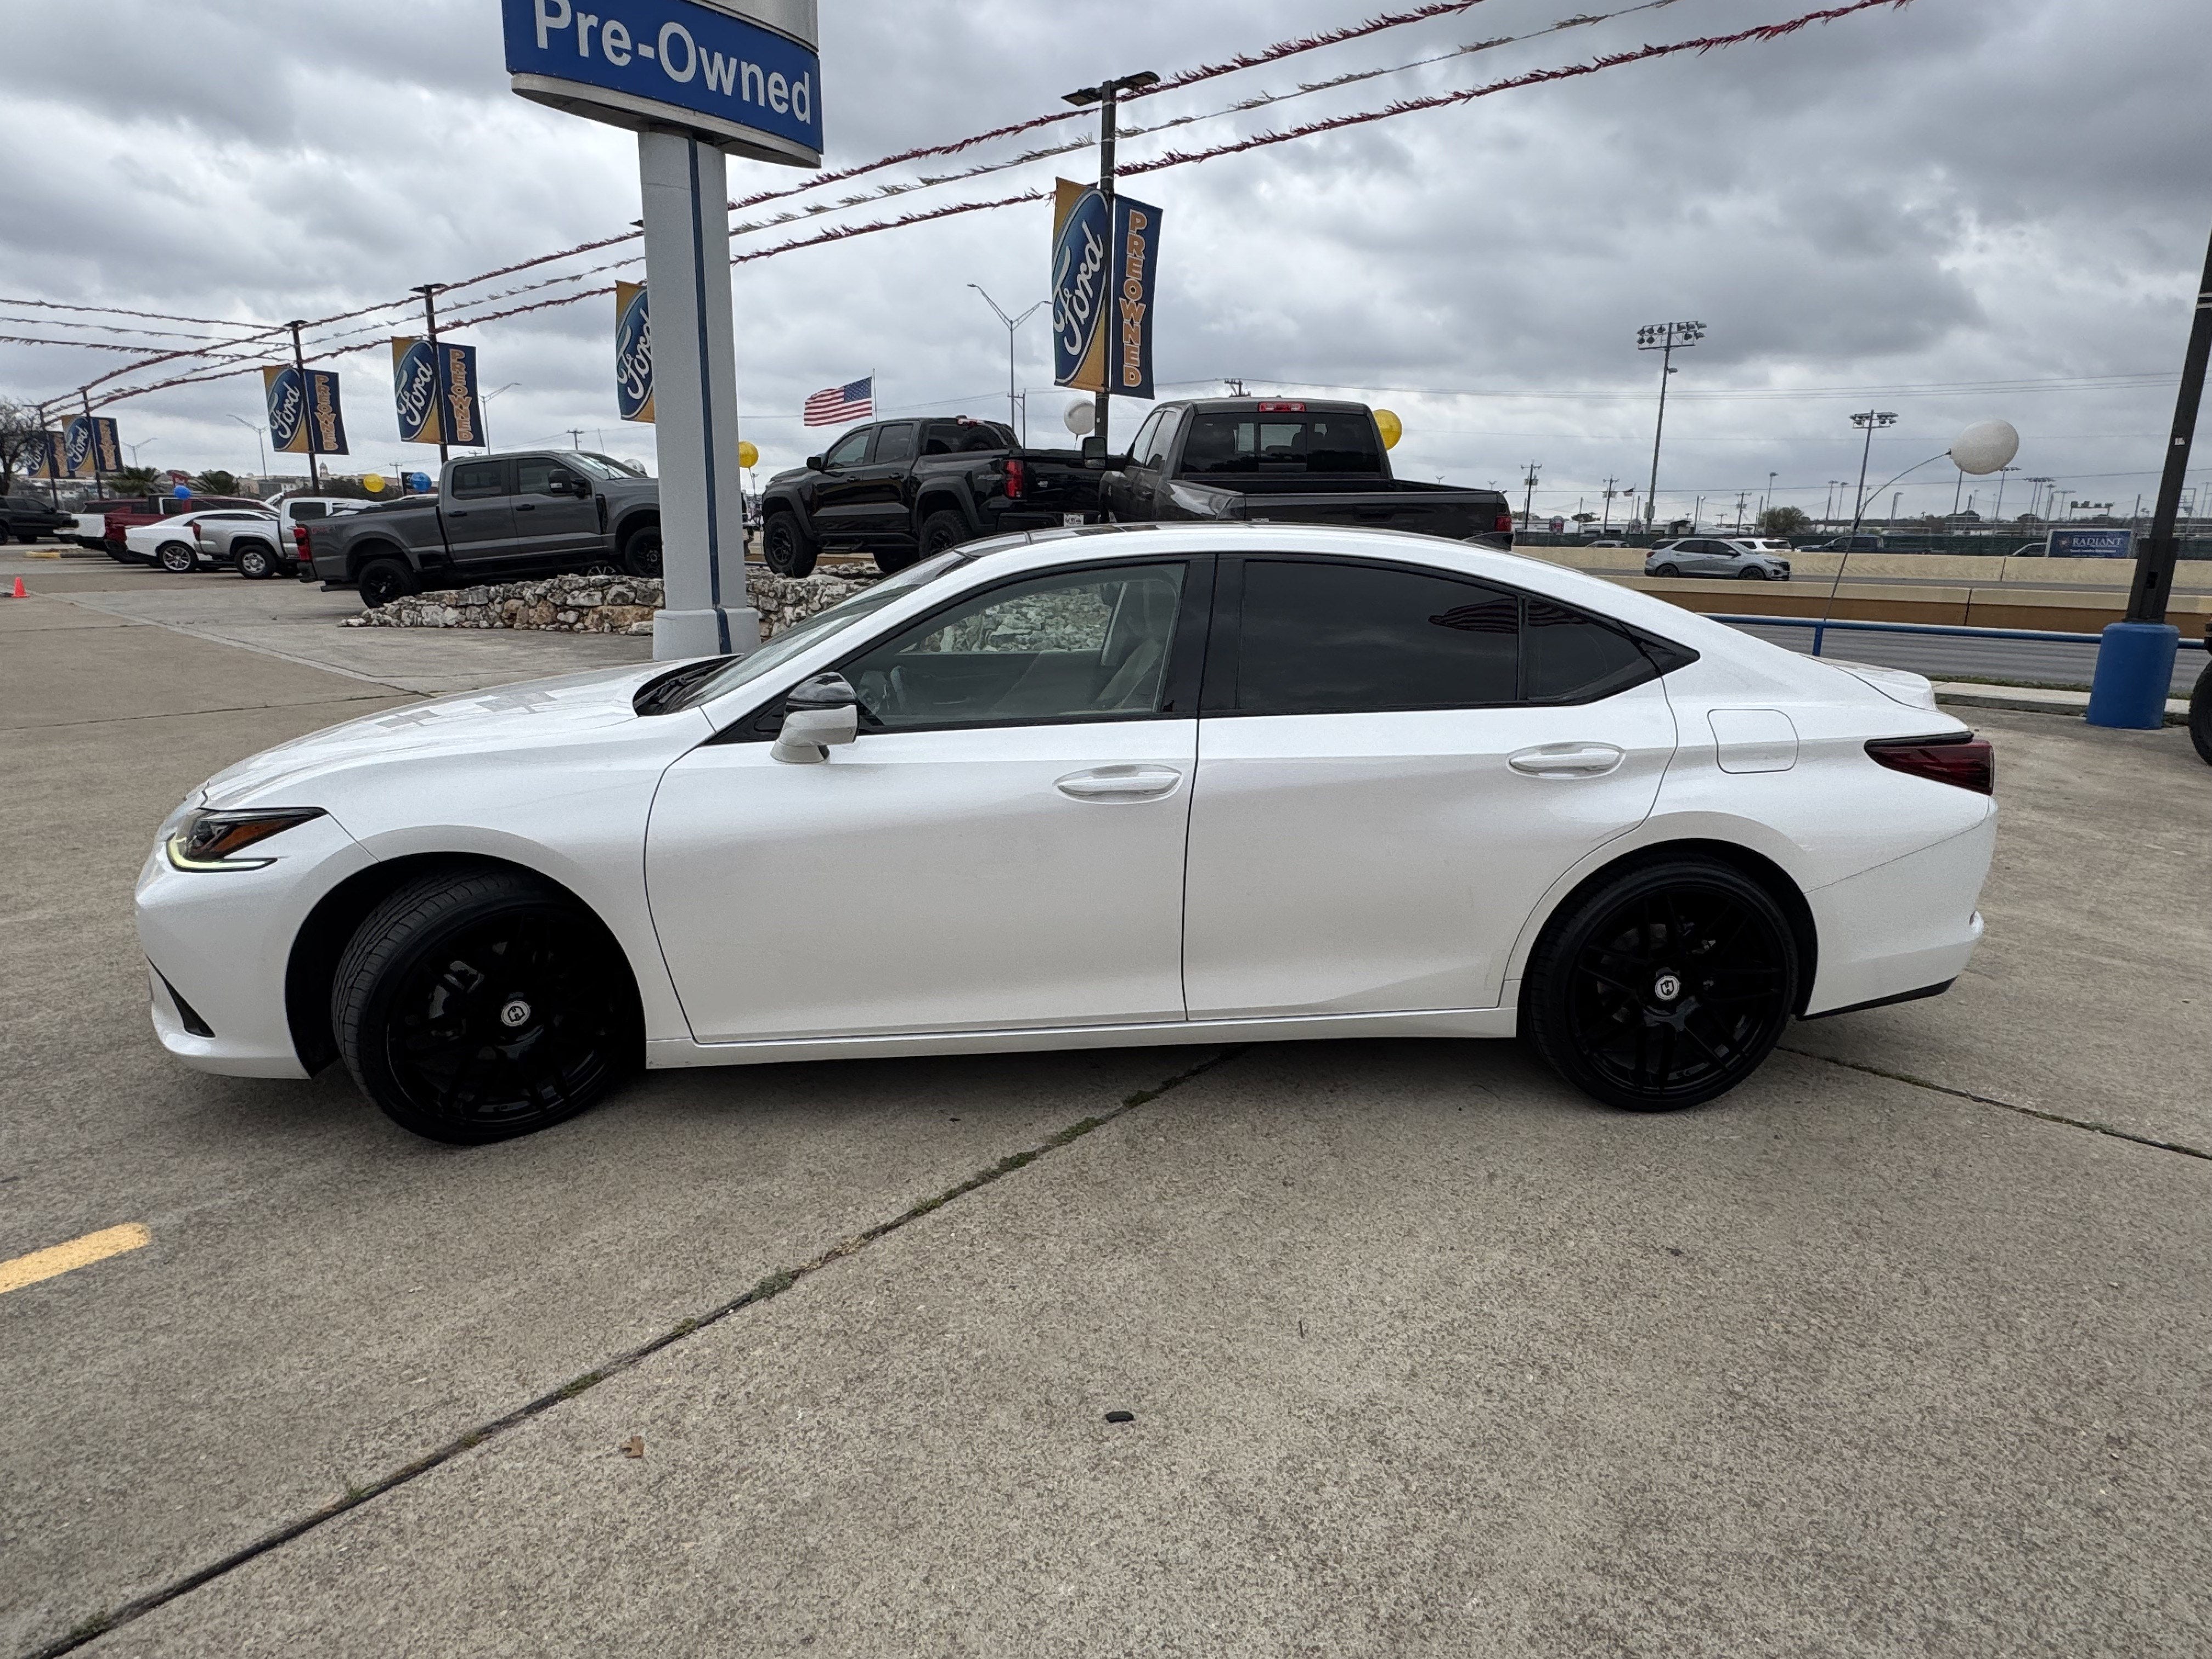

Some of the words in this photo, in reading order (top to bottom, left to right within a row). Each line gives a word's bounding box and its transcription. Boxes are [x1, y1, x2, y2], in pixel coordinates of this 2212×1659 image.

[535, 0, 811, 125] Pre-Owned
[1053, 220, 1104, 356] Ford
[1118, 209, 1148, 387] PREOWNED
[269, 381, 301, 439] Ford
[396, 356, 433, 426] Ford
[448, 348, 474, 441] PREOWNED
[65, 425, 89, 463] Ford
[2072, 537, 2123, 546] RADIANT
